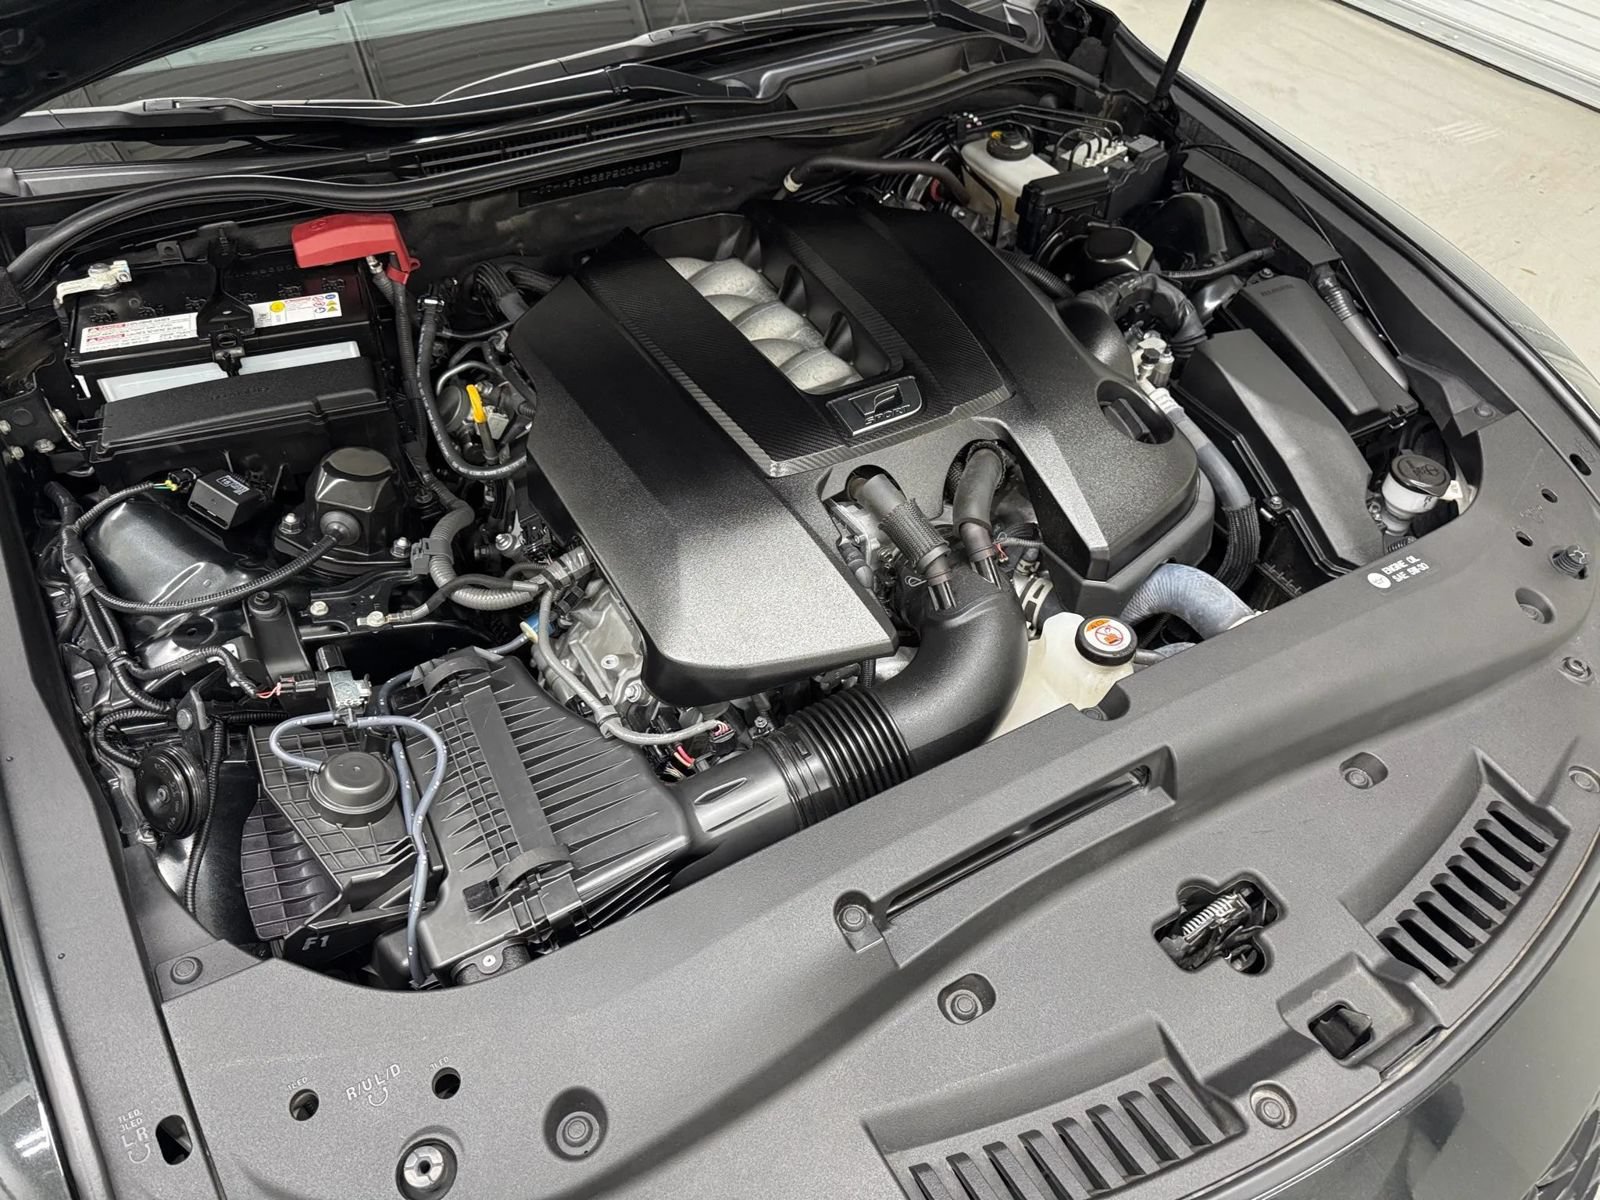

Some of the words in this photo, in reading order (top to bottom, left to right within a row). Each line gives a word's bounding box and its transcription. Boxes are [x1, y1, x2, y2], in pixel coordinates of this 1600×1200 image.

[864, 404, 911, 425] SPORT
[302, 935, 331, 951] F1
[136, 1126, 148, 1141] R
